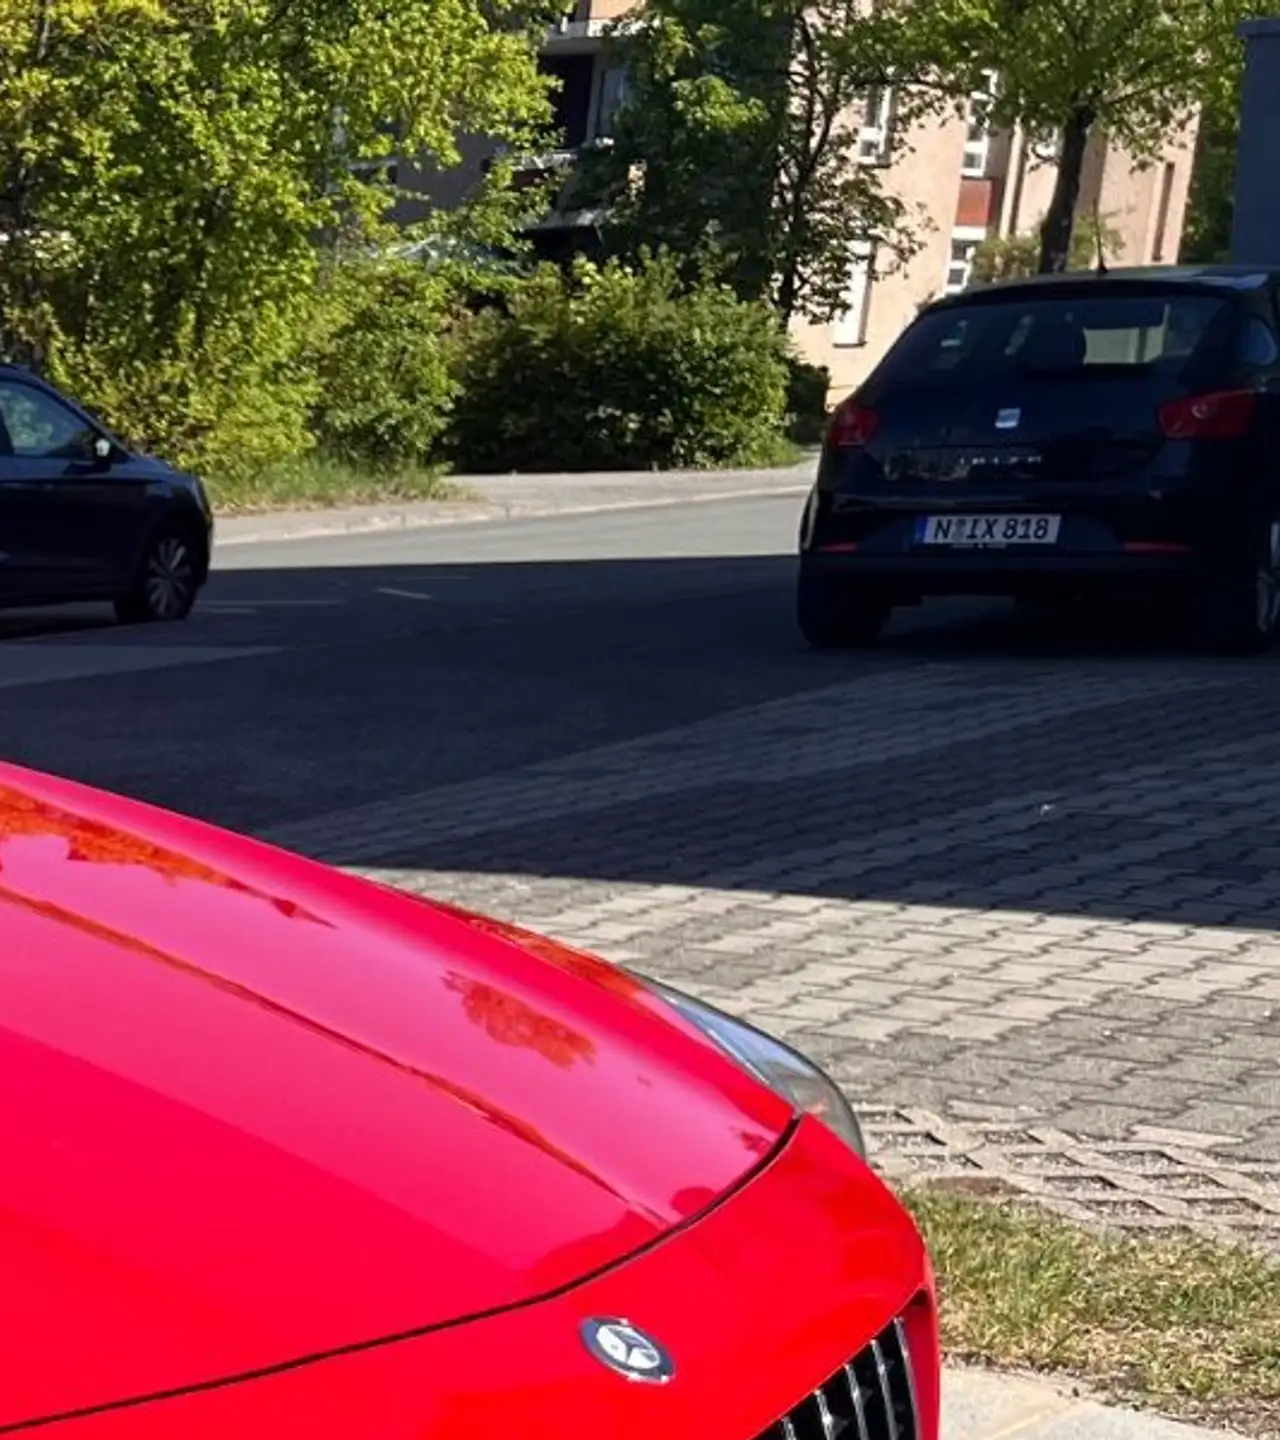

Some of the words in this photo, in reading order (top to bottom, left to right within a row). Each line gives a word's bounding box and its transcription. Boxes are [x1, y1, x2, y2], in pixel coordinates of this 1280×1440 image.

[934, 518, 952, 540] N
[966, 518, 998, 540] IX
[1002, 518, 1050, 540] 818
